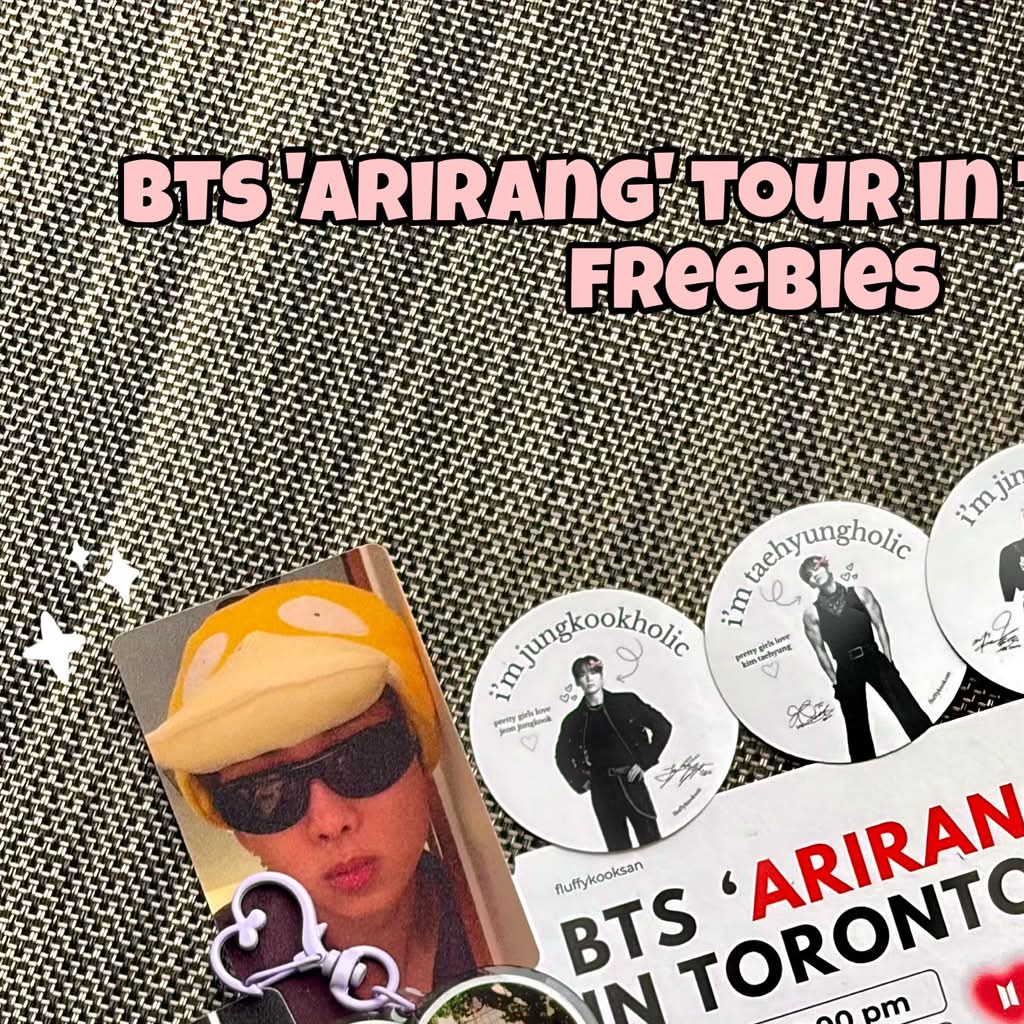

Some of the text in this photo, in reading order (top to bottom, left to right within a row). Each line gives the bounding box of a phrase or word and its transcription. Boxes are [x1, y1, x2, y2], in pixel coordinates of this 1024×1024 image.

[955, 489, 996, 527] i'm
[721, 519, 912, 627] i'm taehyungholic
[489, 606, 690, 702] i'm jungkookholic
[735, 633, 791, 662] pretty girls love
[741, 643, 792, 670] kim taehyung
[494, 706, 551, 728] pretty girls love
[554, 858, 645, 897] fluffykooksan
[560, 888, 697, 977] BTS
